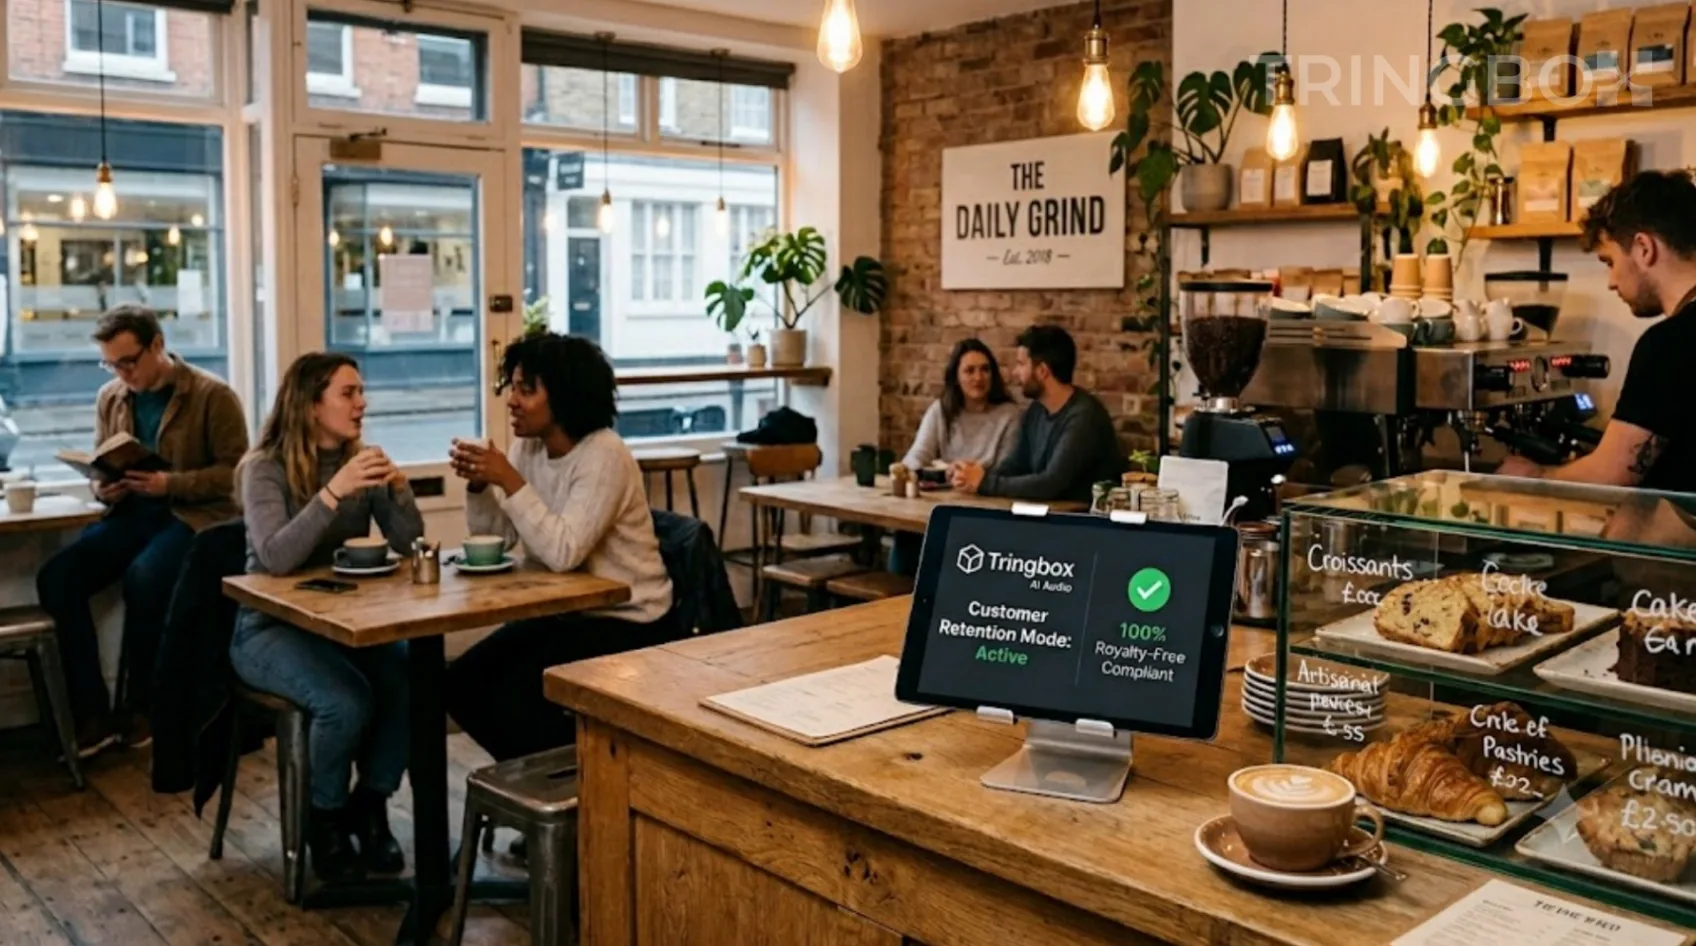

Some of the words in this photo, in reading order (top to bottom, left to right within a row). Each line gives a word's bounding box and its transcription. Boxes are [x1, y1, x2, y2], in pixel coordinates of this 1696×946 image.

[1011, 161, 1045, 191] THE
[956, 201, 1020, 240] DAILY
[1028, 195, 1105, 237] GRIND
[988, 551, 1075, 578] Tringbox
[1307, 543, 1414, 581] Croissants
[1029, 580, 1040, 589] AI
[1042, 580, 1073, 593] Audio
[968, 600, 1049, 622] Customer
[1631, 588, 1696, 625] Cake
[939, 618, 1017, 641] Retention
[1020, 627, 1073, 648] Mode:
[1120, 621, 1167, 642] 100%
[975, 645, 1028, 665] Active
[1095, 640, 1187, 664] Royalty-Free
[1101, 660, 1175, 683] Compliant
[1483, 735, 1565, 775] Pastries
